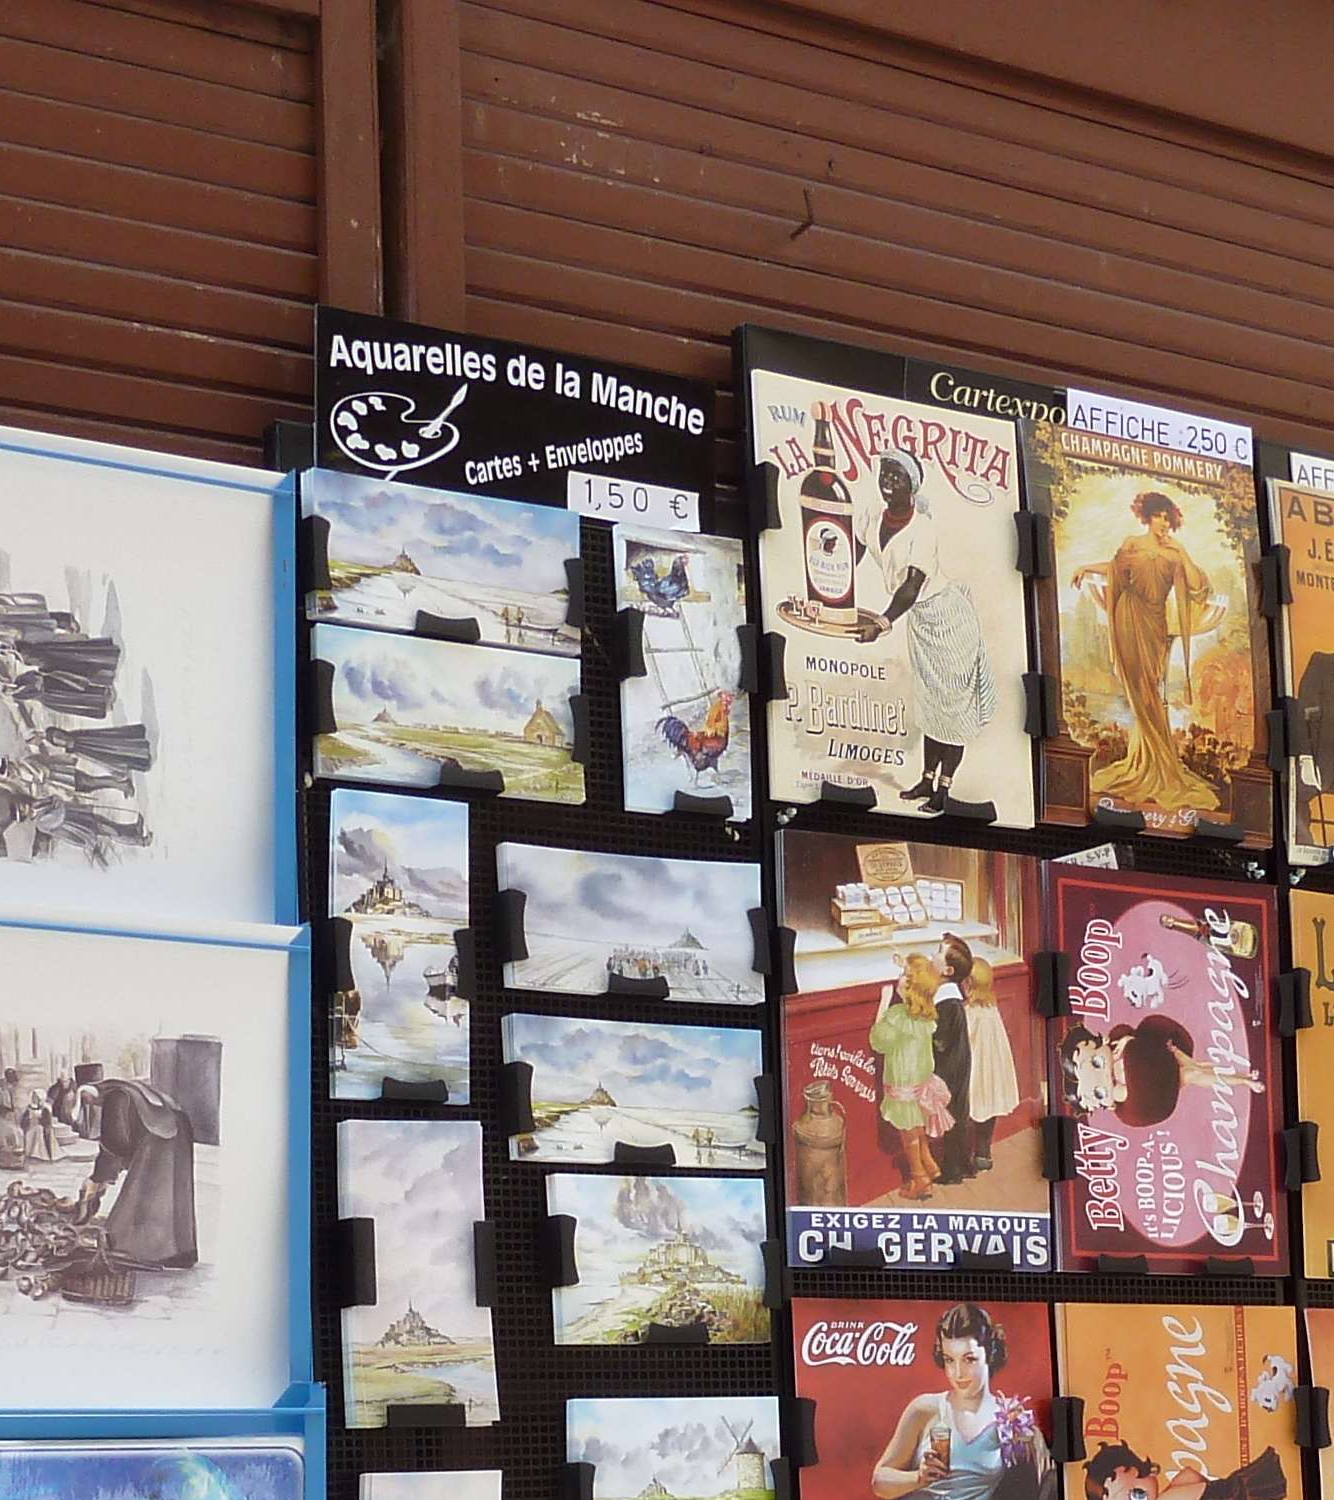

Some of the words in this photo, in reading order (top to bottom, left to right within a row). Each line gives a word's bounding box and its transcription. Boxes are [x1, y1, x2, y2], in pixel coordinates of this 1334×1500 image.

[329, 333, 497, 383] Aquarelles
[506, 354, 546, 391] de
[554, 361, 581, 400] la
[590, 372, 706, 436] Manche
[767, 404, 807, 428] RUM
[464, 453, 524, 486] Cartes
[544, 430, 645, 472] Enveloppes
[769, 436, 816, 481] LA
[830, 397, 1012, 493] NEGRITA
[1059, 432, 1149, 470] CHAMPAGNE
[1152, 448, 1223, 483] POMMERY
[583, 477, 649, 513] 1,50
[806, 656, 886, 681] MONOPOLE
[805, 678, 908, 737] Bardinet
[827, 737, 906, 766] LIMOGES
[1071, 917, 1123, 1022] Boop
[1193, 906, 1250, 1248] Champagne
[1073, 1122, 1130, 1232] Betty
[810, 1212, 902, 1230] EXIGEZ
[911, 1214, 939, 1230] LA
[948, 1215, 1041, 1235] MARQUE
[801, 1320, 919, 1368] Coca-Cola
[830, 1319, 866, 1331] DRINK
[1085, 1360, 1130, 1441] Boop
